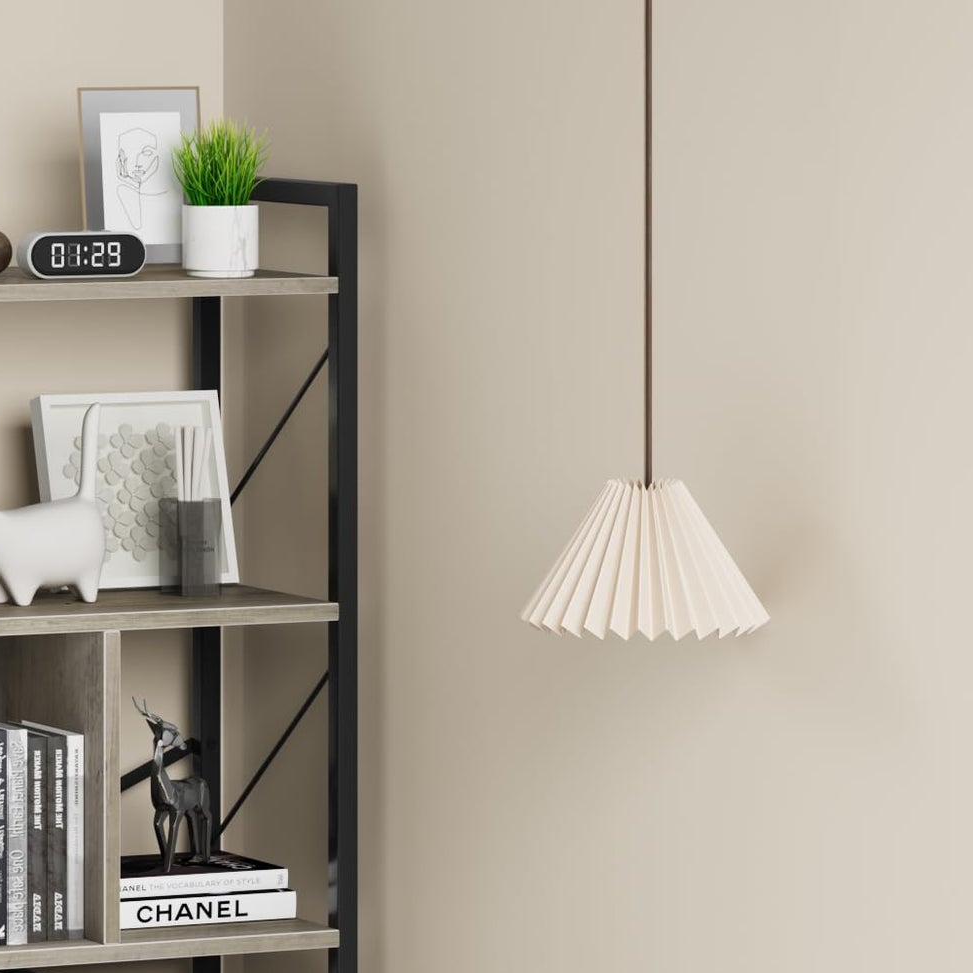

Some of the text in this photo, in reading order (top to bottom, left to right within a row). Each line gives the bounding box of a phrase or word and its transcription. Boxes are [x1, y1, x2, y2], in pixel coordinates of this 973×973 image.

[51, 242, 121, 268] 01:29
[122, 884, 147, 892] ANEL
[149, 883, 164, 891] THE
[167, 880, 221, 890] VOCABULARY
[237, 877, 260, 885] STYLE
[136, 900, 249, 923] CHANEL
